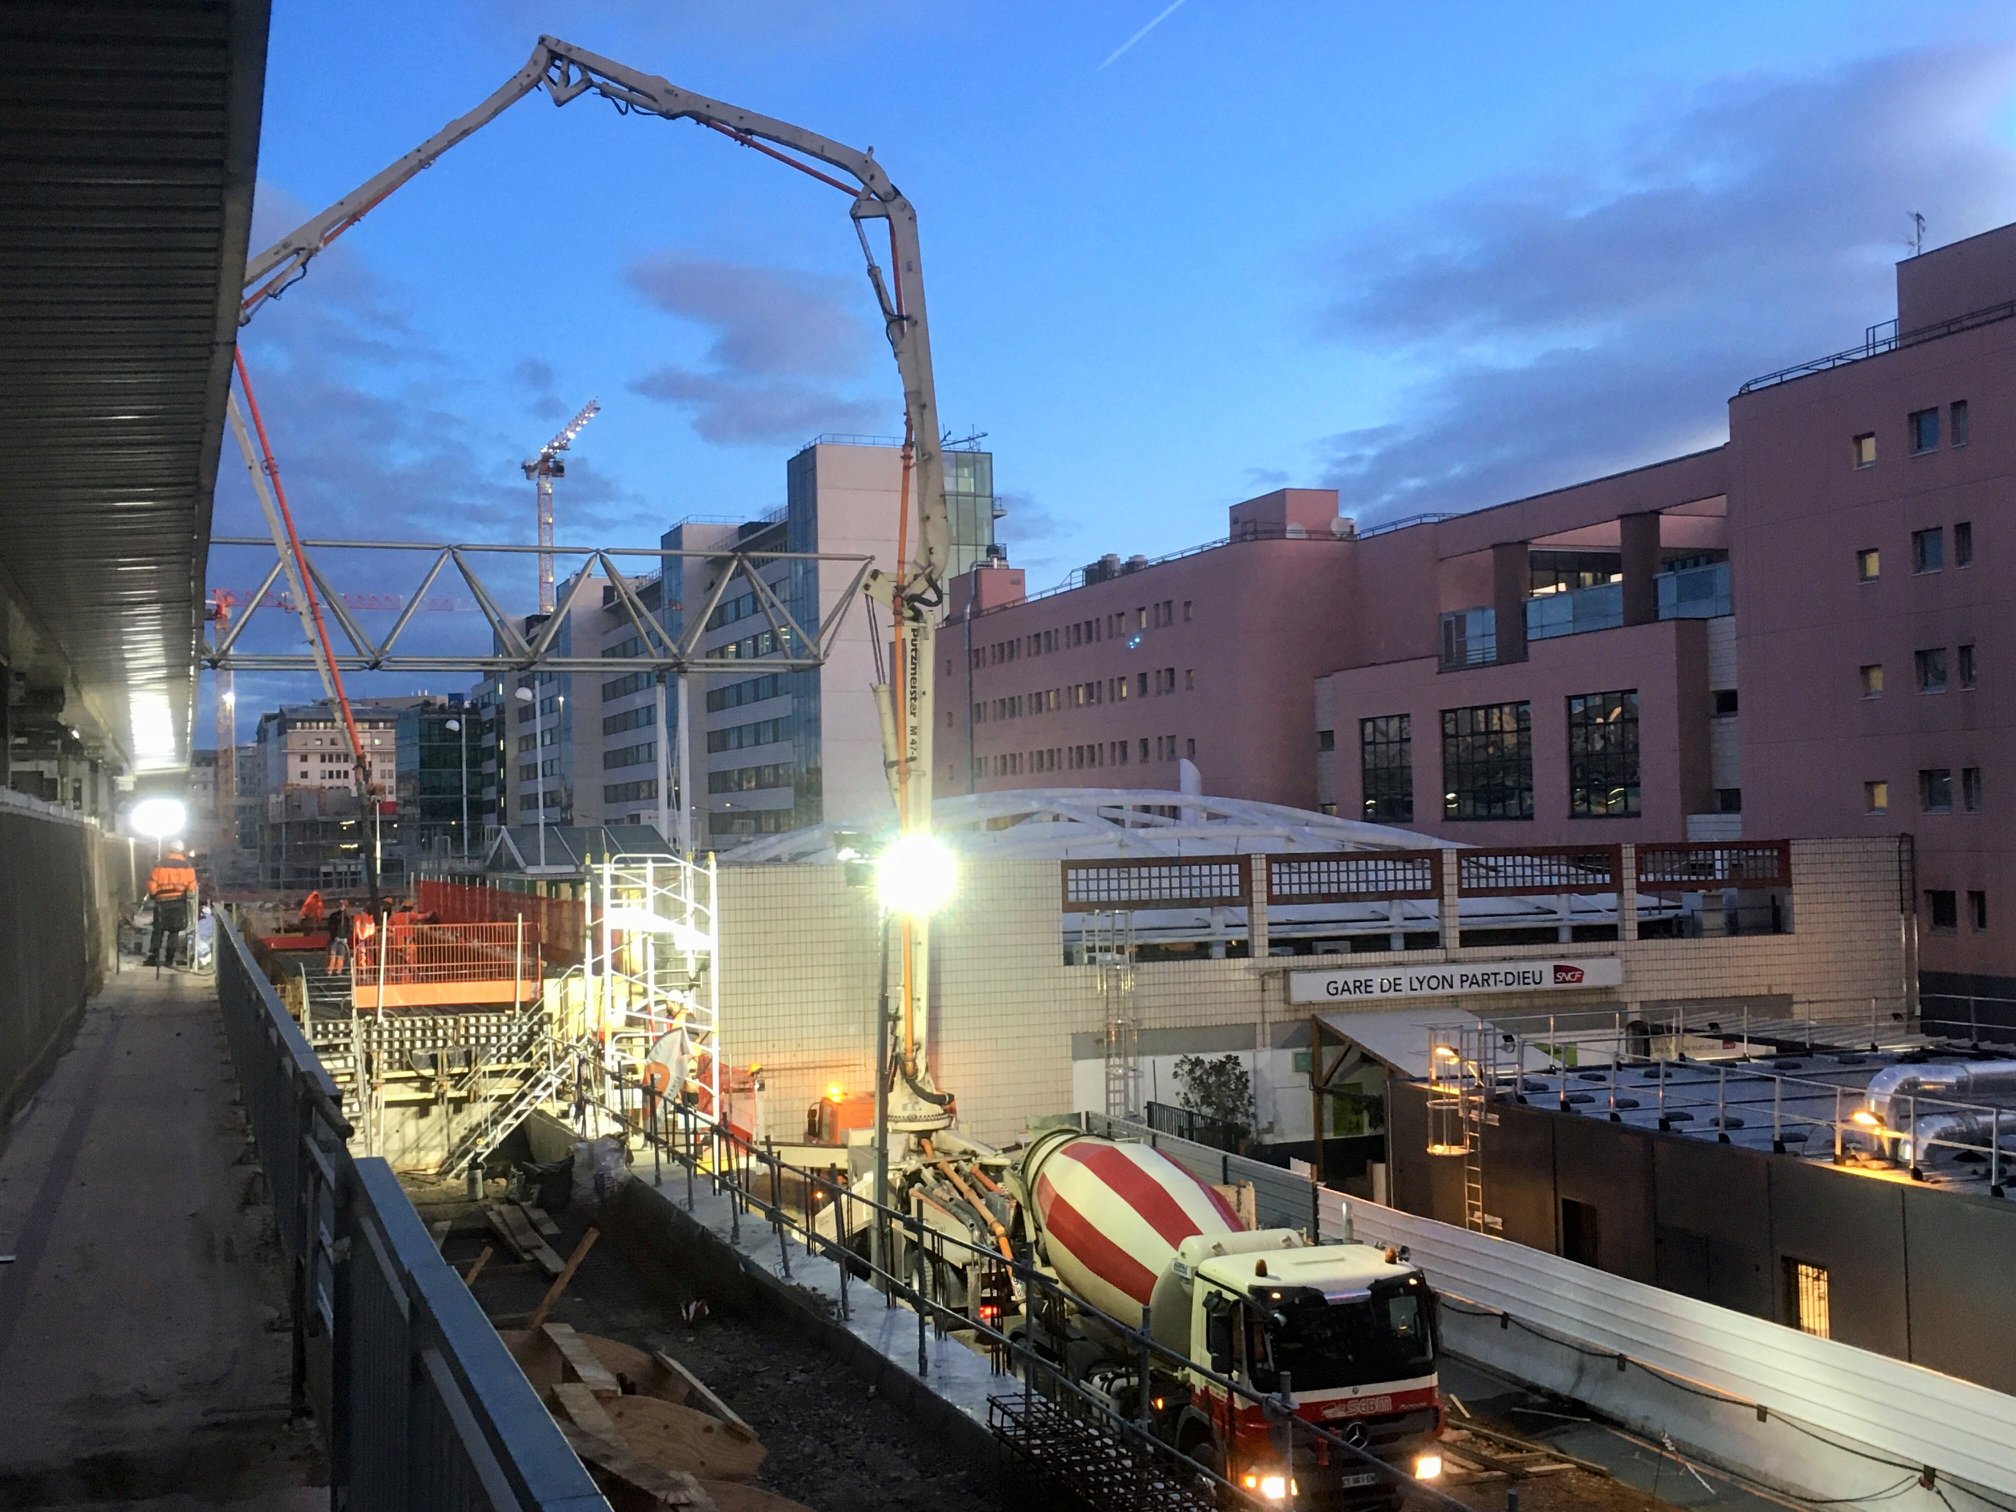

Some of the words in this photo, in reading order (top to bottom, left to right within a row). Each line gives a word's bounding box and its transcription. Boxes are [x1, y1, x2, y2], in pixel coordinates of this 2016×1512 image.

[909, 628, 920, 718] Putzmeister
[909, 725, 918, 736] M
[1326, 978, 1374, 996] GARE
[1380, 977, 1403, 993] DE
[1409, 974, 1454, 991] LYON
[1460, 970, 1543, 989] PART-DIEU
[1555, 970, 1582, 982] SNCF
[1346, 1395, 1392, 1416] SEBM
